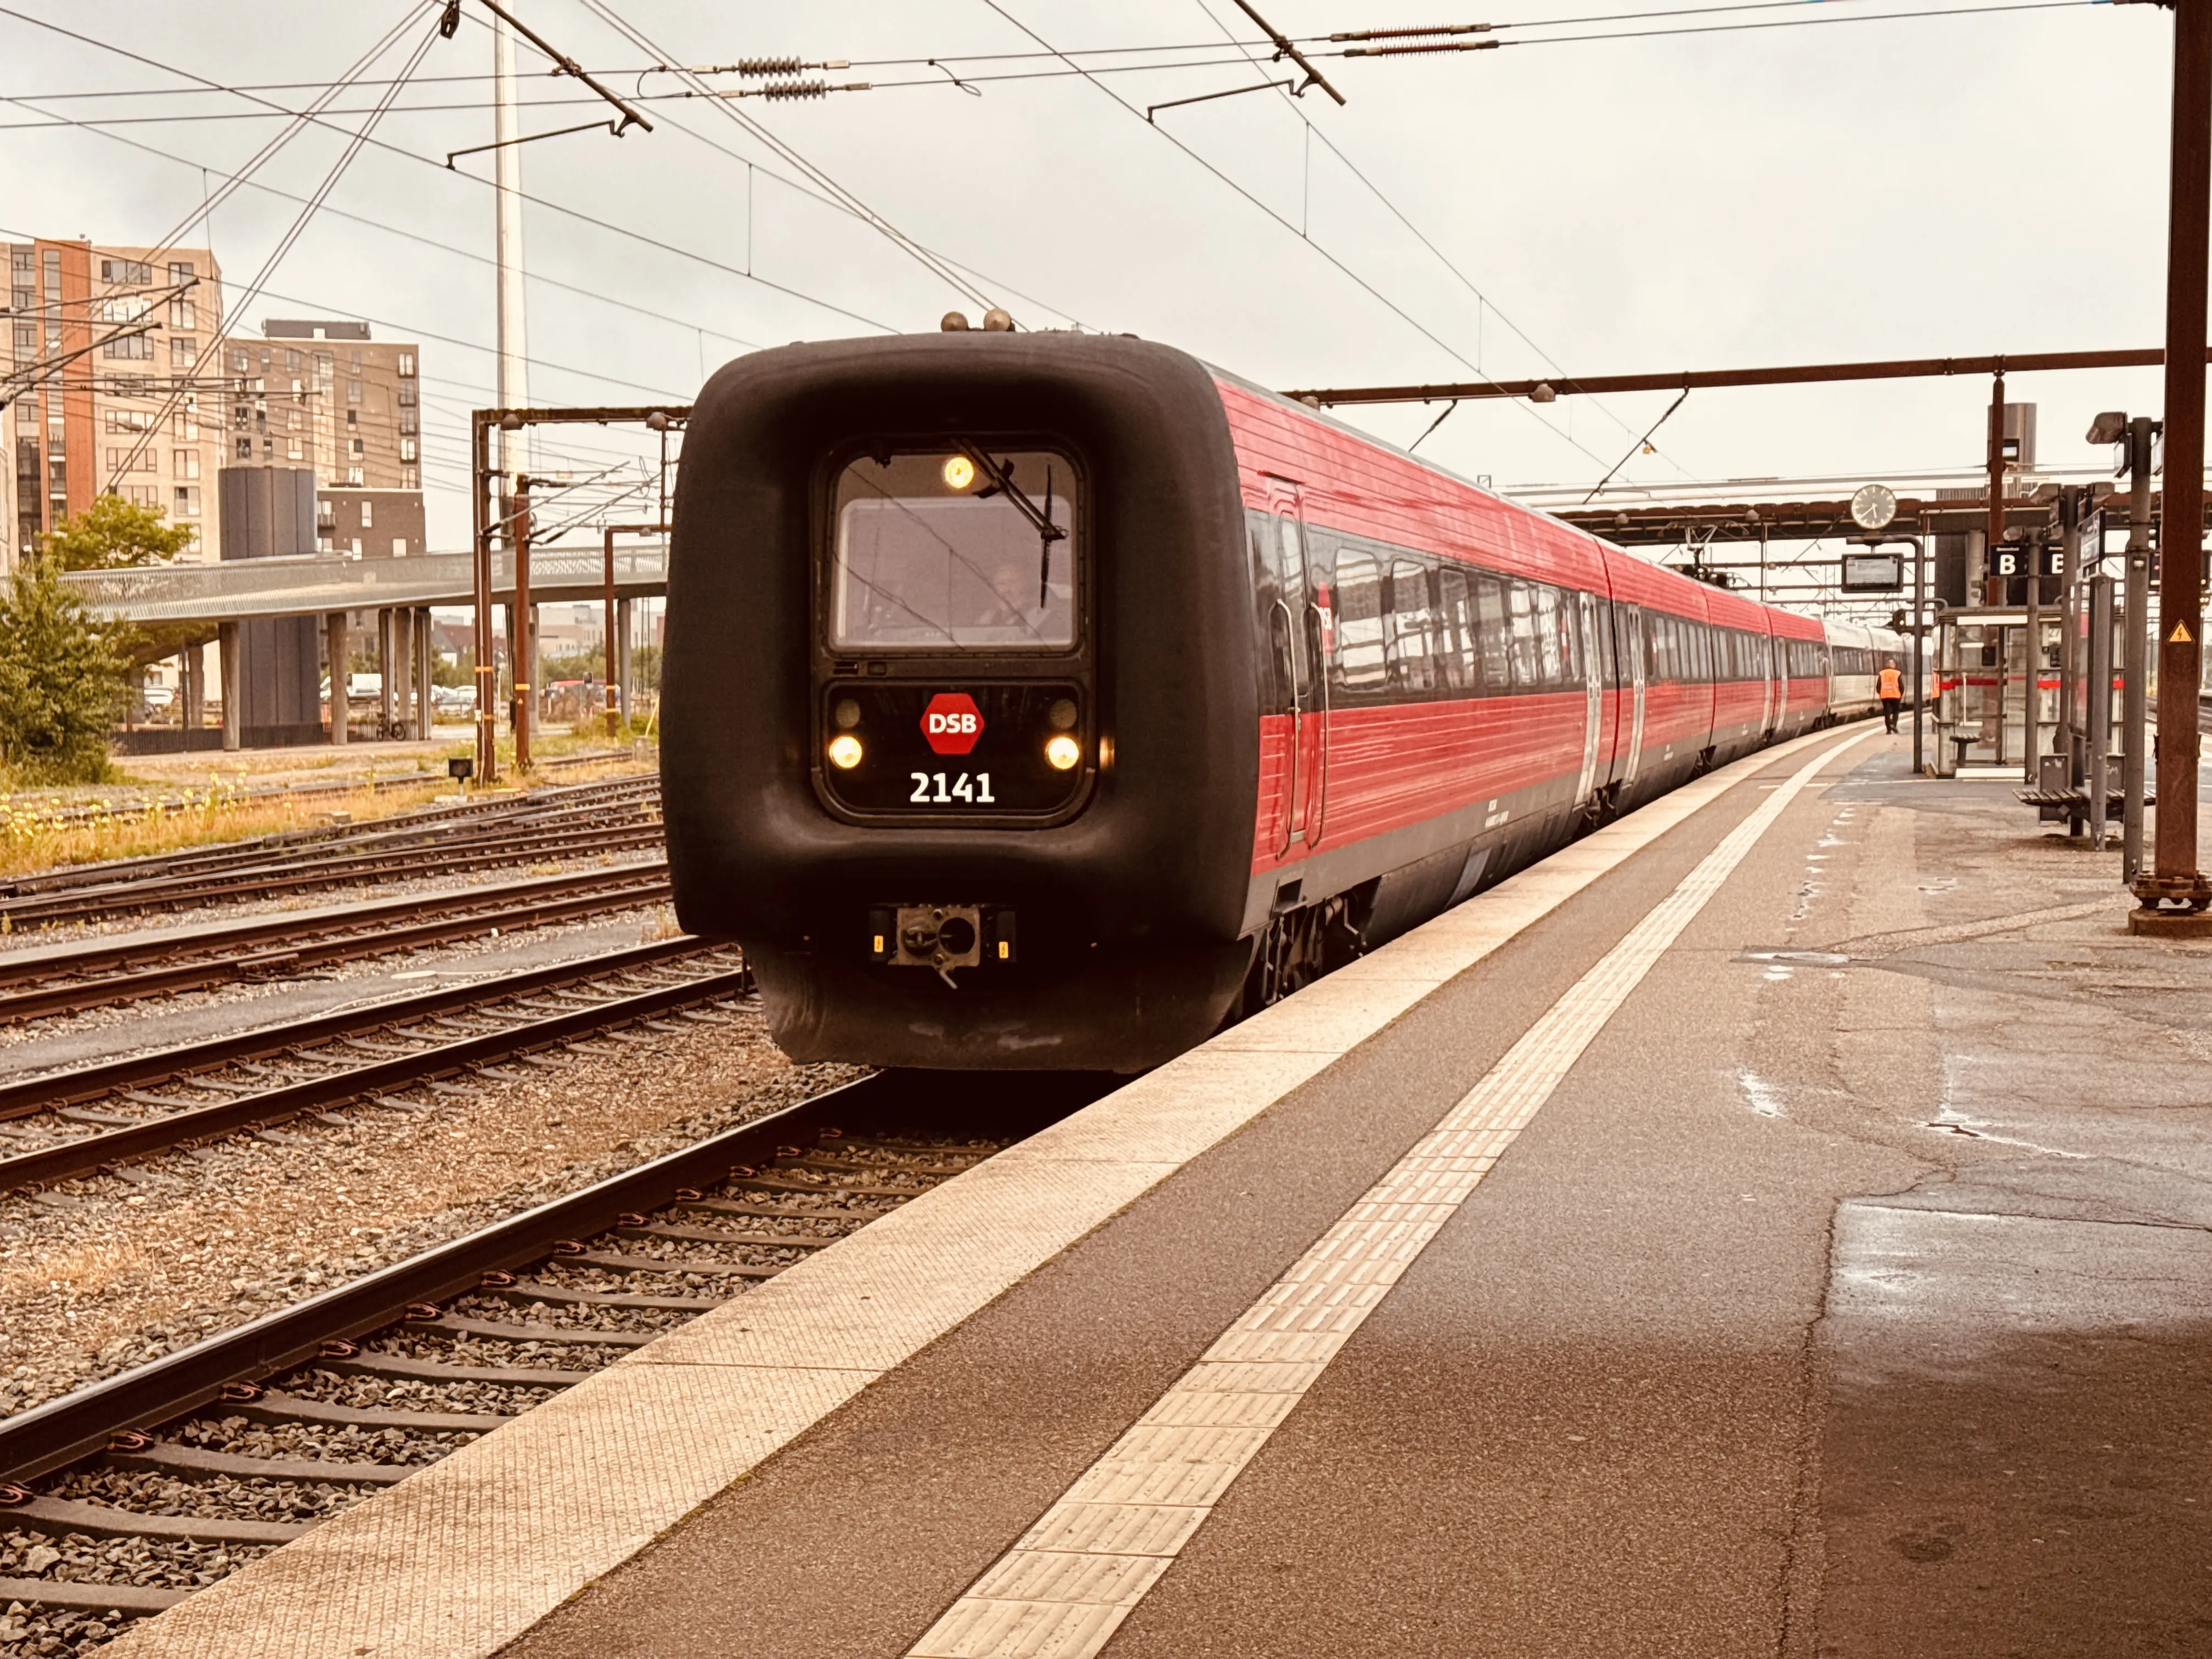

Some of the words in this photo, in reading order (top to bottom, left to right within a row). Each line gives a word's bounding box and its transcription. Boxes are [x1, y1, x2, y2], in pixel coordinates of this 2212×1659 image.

[2000, 554, 2016, 575] B
[929, 713, 977, 733] DSB
[910, 772, 995, 803] 2141
